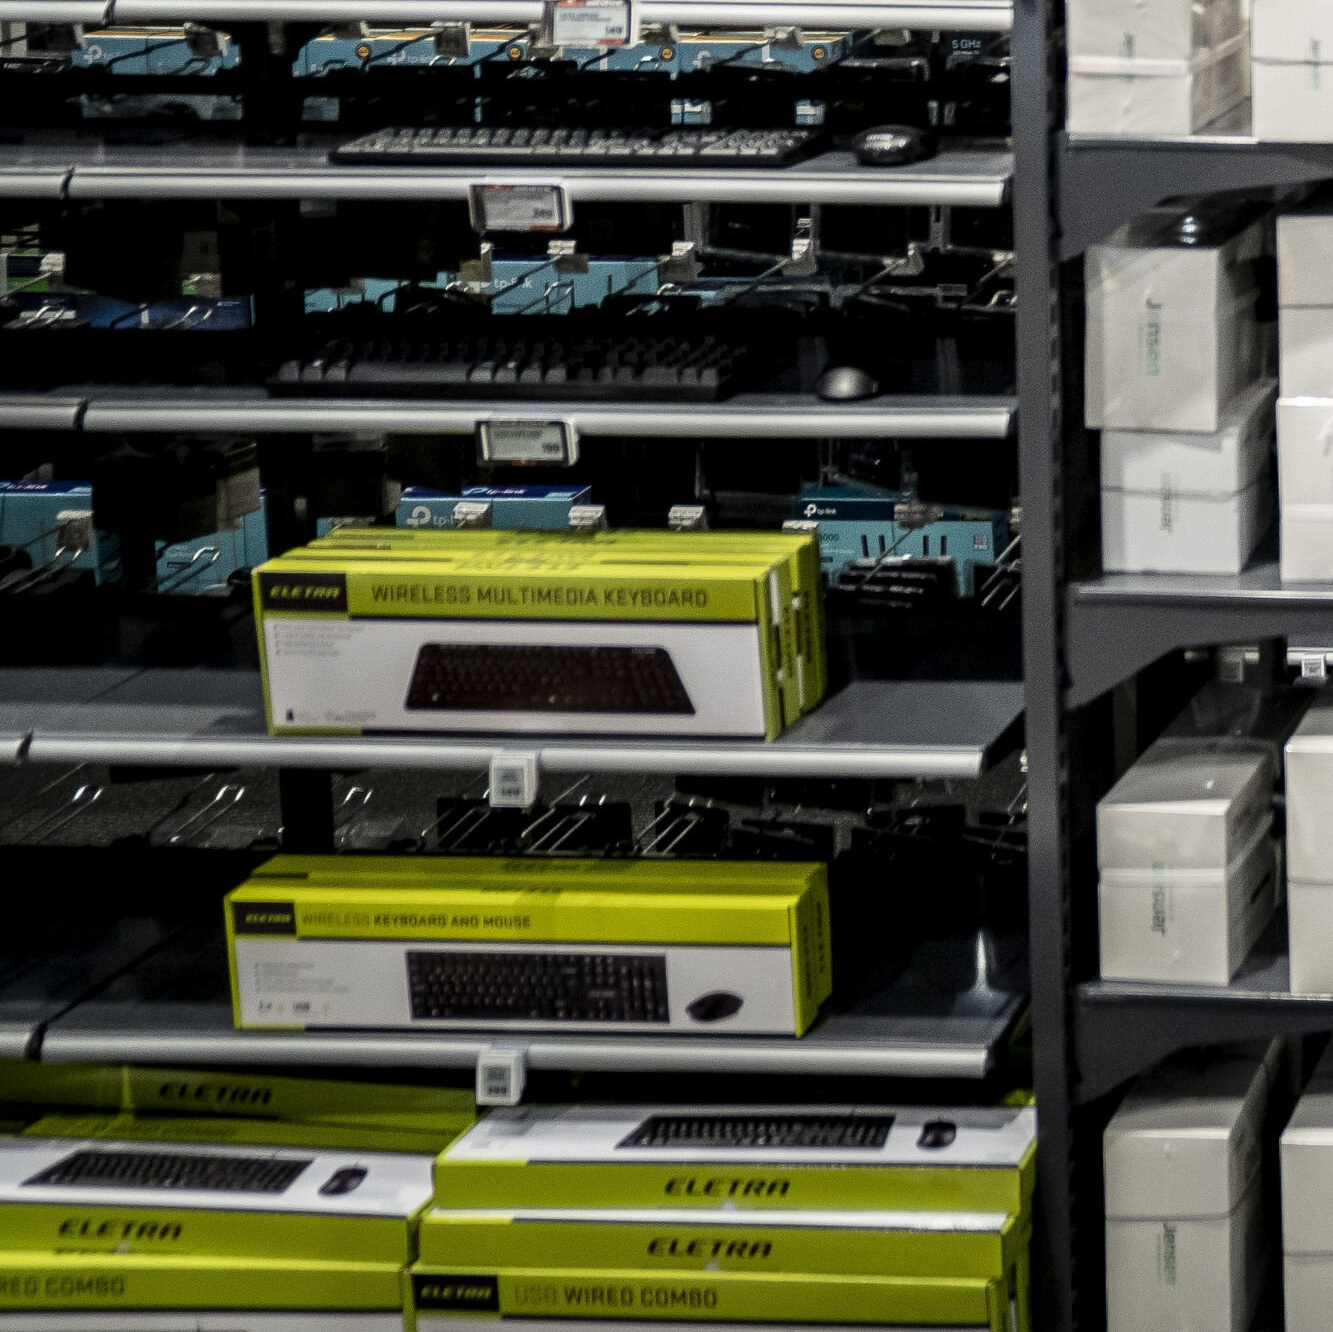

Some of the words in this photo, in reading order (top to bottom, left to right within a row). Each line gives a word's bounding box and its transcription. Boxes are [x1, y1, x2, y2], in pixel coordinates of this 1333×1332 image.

[961, 38, 982, 50] GHz
[270, 585, 341, 601] ELETRA
[371, 584, 472, 606] WIRELESS
[477, 586, 598, 608] MULTIMEDIA
[603, 588, 709, 609] KEYBOARD
[302, 913, 370, 928] WIRELESS
[373, 913, 447, 928] KEYBOARD
[450, 915, 479, 928] AND
[481, 915, 532, 930] MOUSE
[158, 1080, 274, 1106] ELETRA
[663, 1177, 791, 1198] ELETRA
[57, 1216, 184, 1242] ELETRA
[646, 1237, 774, 1259] ELETRA
[45, 1276, 126, 1298] COMBO
[563, 1287, 634, 1308] WIRED
[639, 1288, 719, 1310] COMBO
